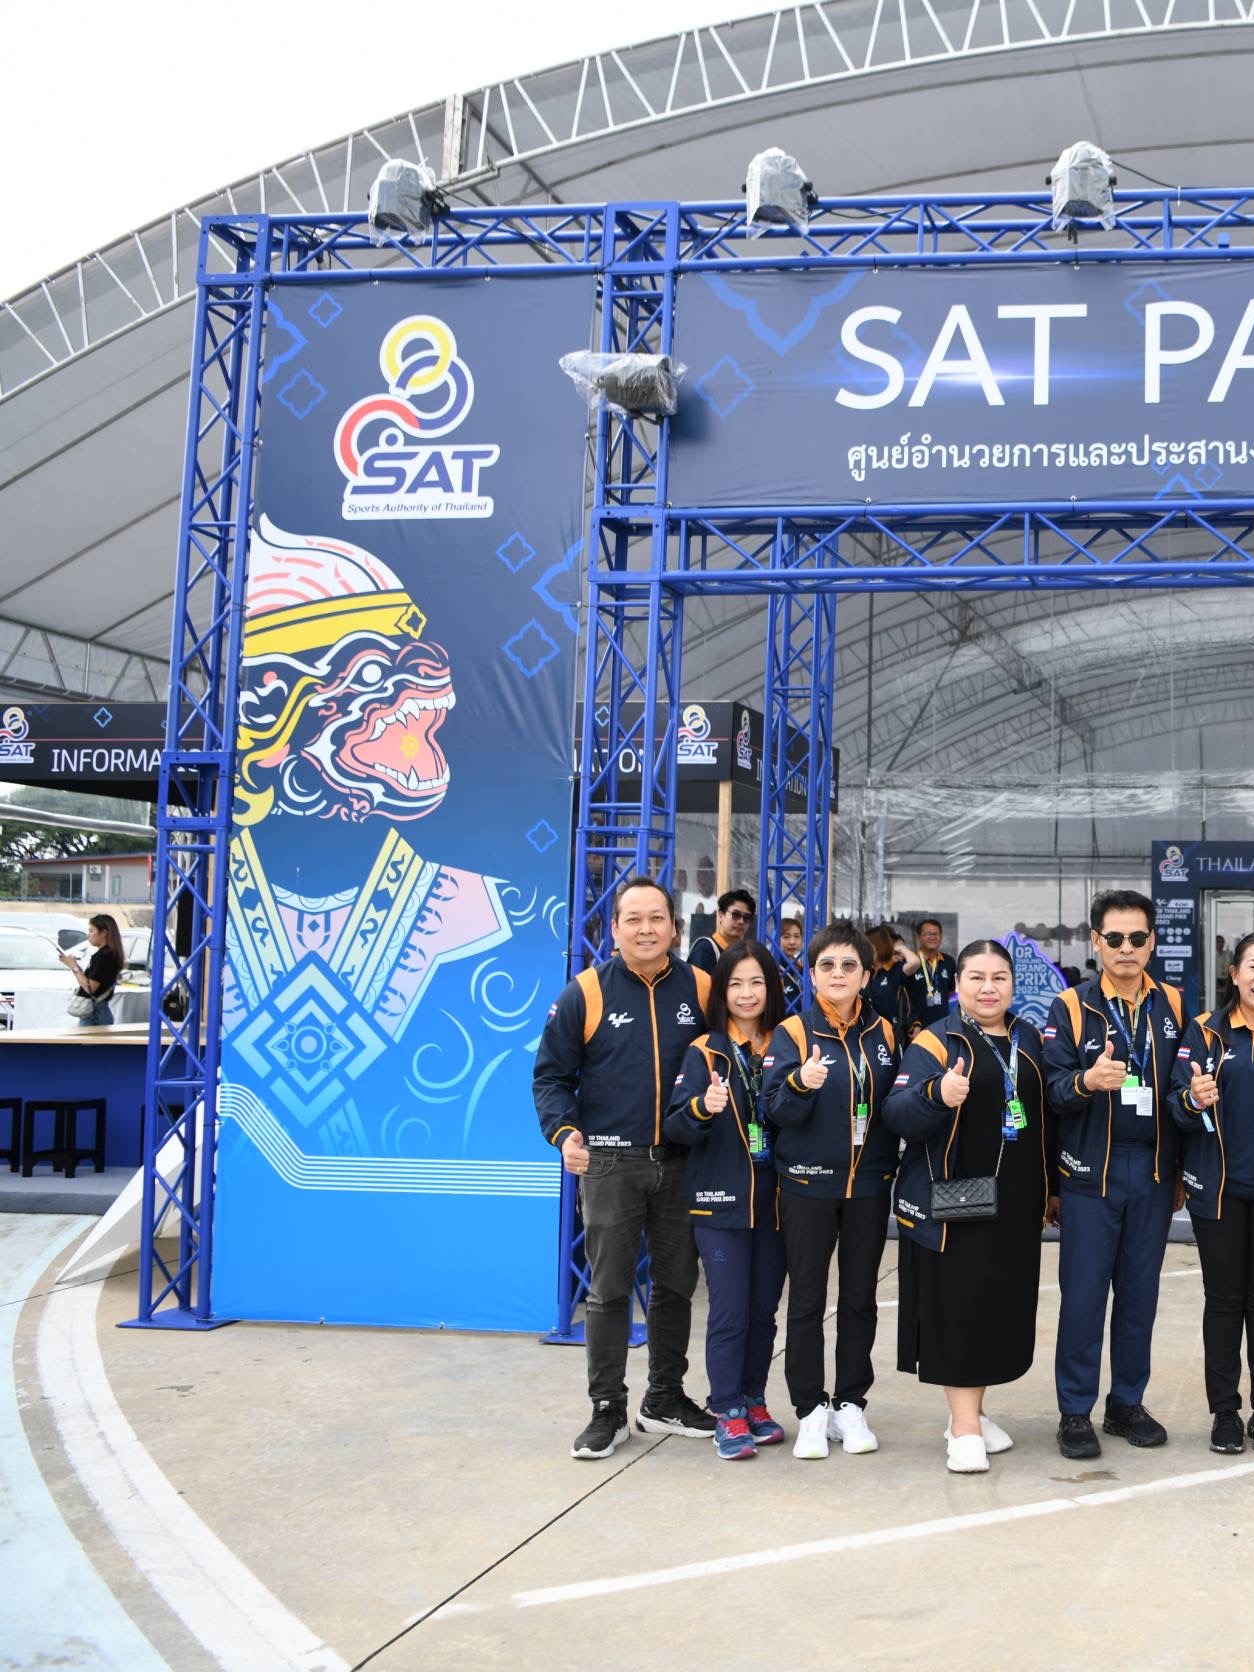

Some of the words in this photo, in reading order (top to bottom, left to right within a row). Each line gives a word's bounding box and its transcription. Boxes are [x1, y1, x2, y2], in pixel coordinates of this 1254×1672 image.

[836, 303, 1088, 410] SAT
[349, 450, 495, 495] SAT
[347, 503, 380, 515] Sports
[383, 502, 428, 514] Authority
[431, 502, 442, 512] of
[444, 501, 488, 512] Thailand
[678, 743, 718, 757] SAT
[1015, 946, 1033, 958] OR
[1015, 964, 1047, 973] GRAND
[1015, 972, 1048, 986] PRIX
[1015, 986, 1039, 994] 2023
